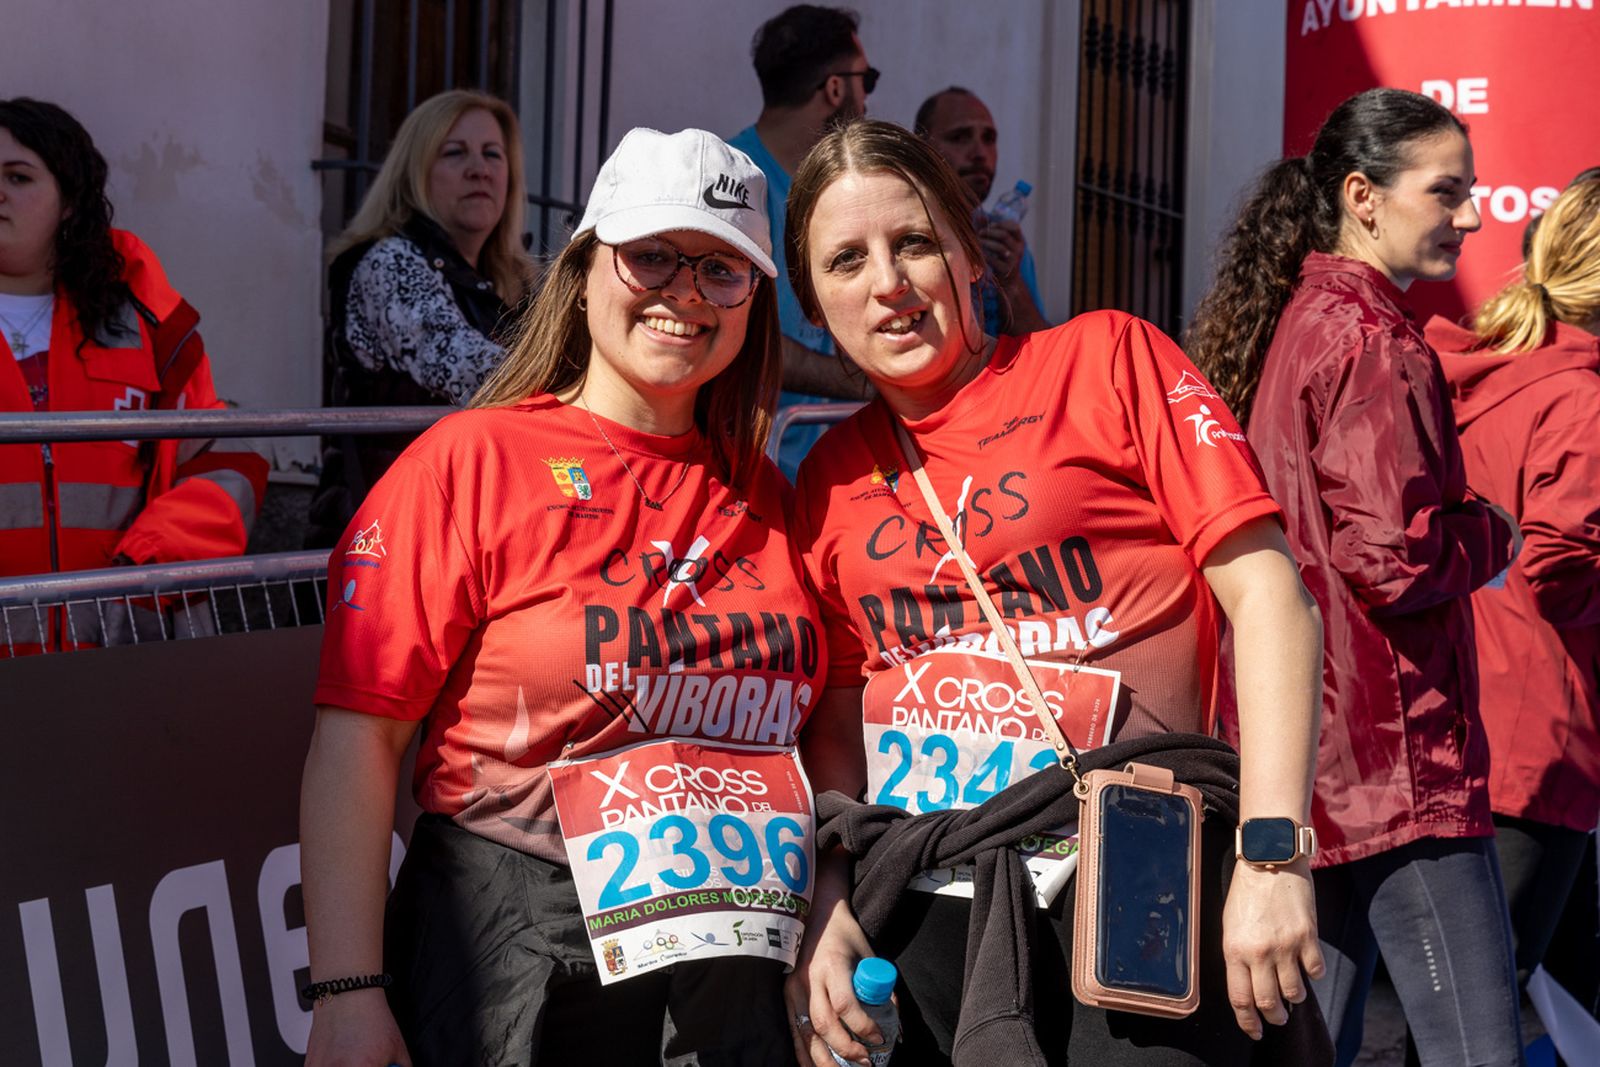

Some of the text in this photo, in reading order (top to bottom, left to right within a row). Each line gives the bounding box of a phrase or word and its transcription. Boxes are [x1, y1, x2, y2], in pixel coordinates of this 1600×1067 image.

[1421, 78, 1489, 114] DE
[716, 173, 749, 206] NIKE
[1471, 186, 1561, 223] TOS
[866, 471, 1029, 561] CROSS
[600, 548, 766, 591] CROSS
[585, 605, 819, 680] PANTANO
[585, 661, 635, 693] DEL
[893, 662, 1065, 720] X CROSS
[892, 707, 1028, 743] PANTANO
[590, 761, 640, 808] X
[645, 763, 768, 796] CROSS
[601, 790, 748, 831] PANTANO
[587, 814, 809, 911] 2396
[588, 909, 642, 931] MARIA
[643, 890, 721, 916] DOLORES
